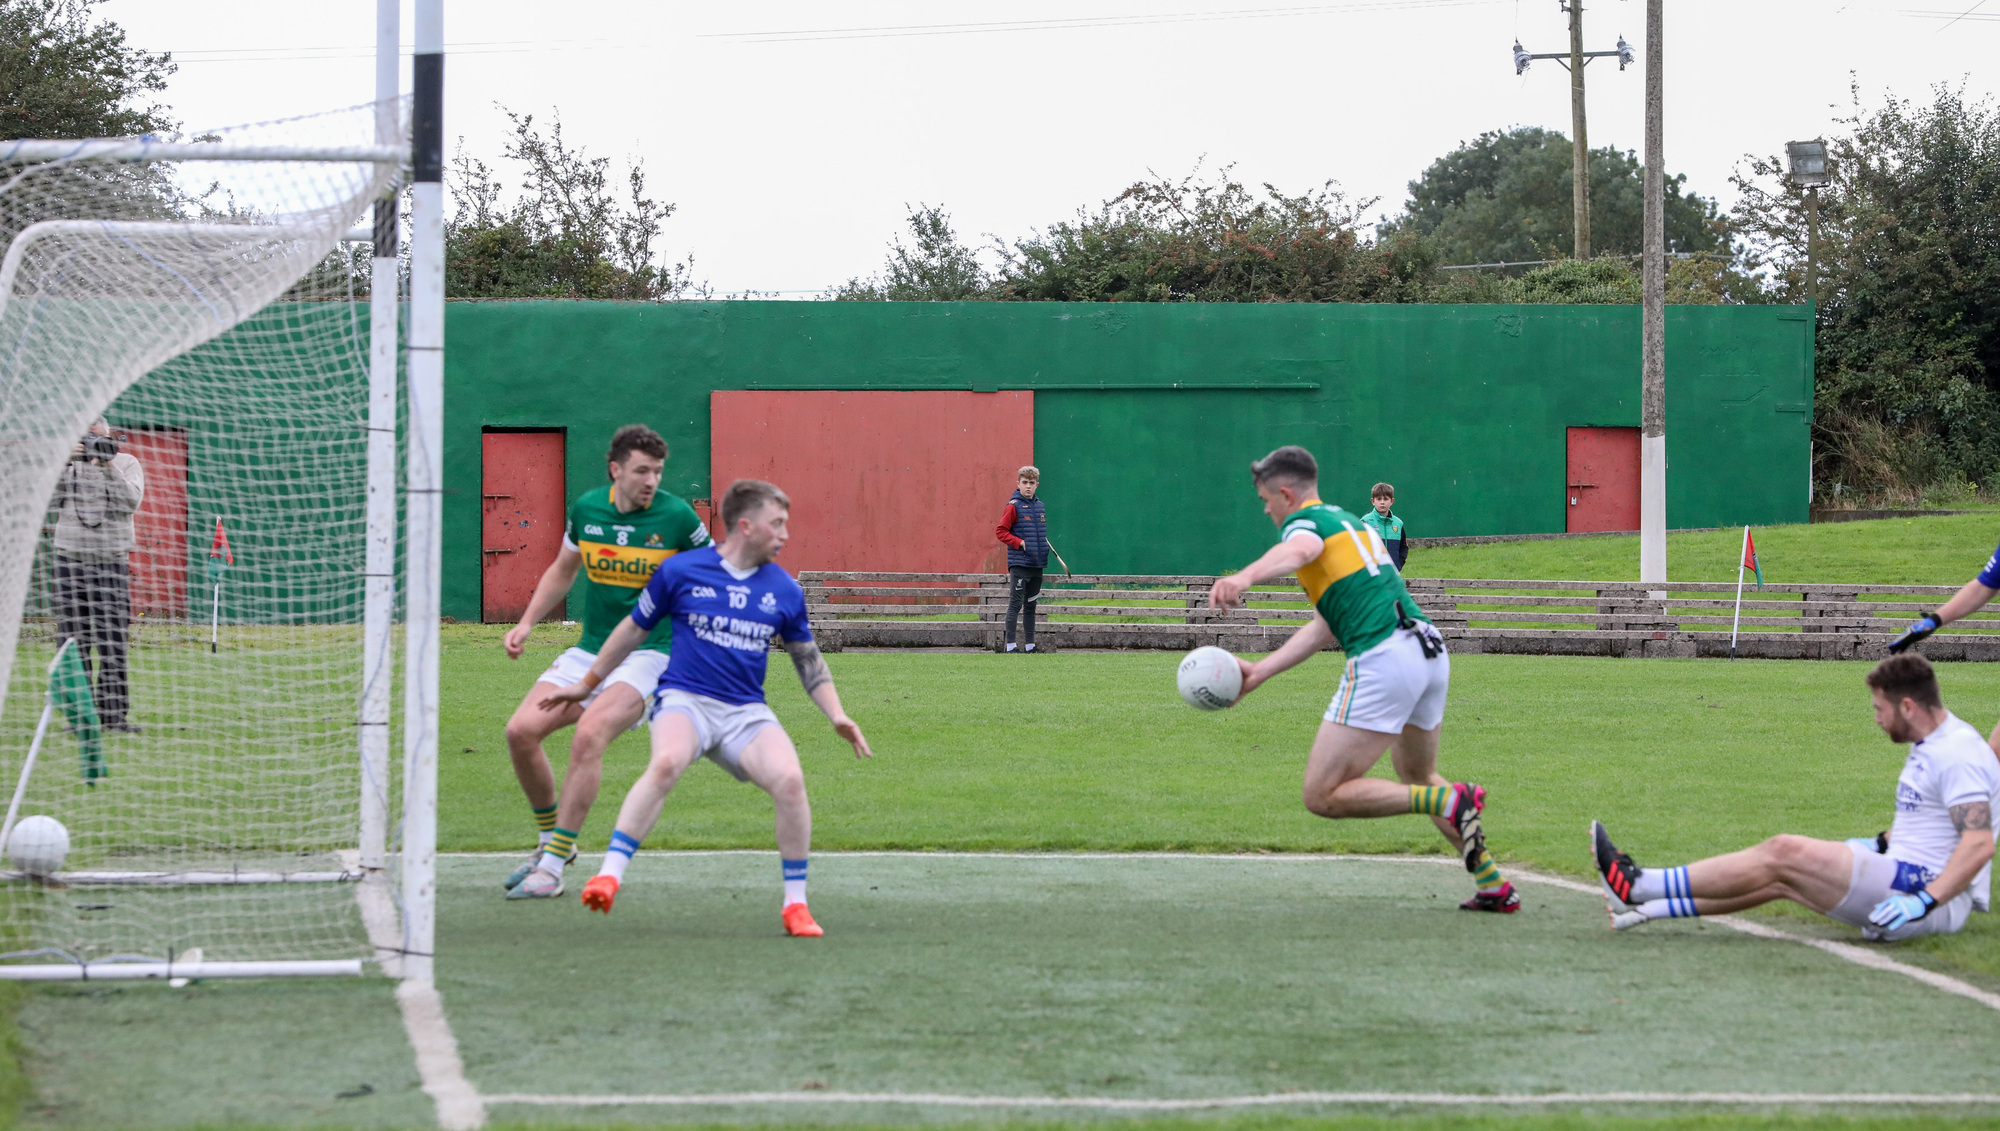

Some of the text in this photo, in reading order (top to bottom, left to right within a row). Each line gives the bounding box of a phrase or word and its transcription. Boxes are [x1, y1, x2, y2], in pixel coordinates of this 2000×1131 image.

[616, 531, 628, 546] 8
[586, 552, 659, 576] Londis
[728, 592, 748, 609] 10
[730, 618, 775, 639] DWYER
